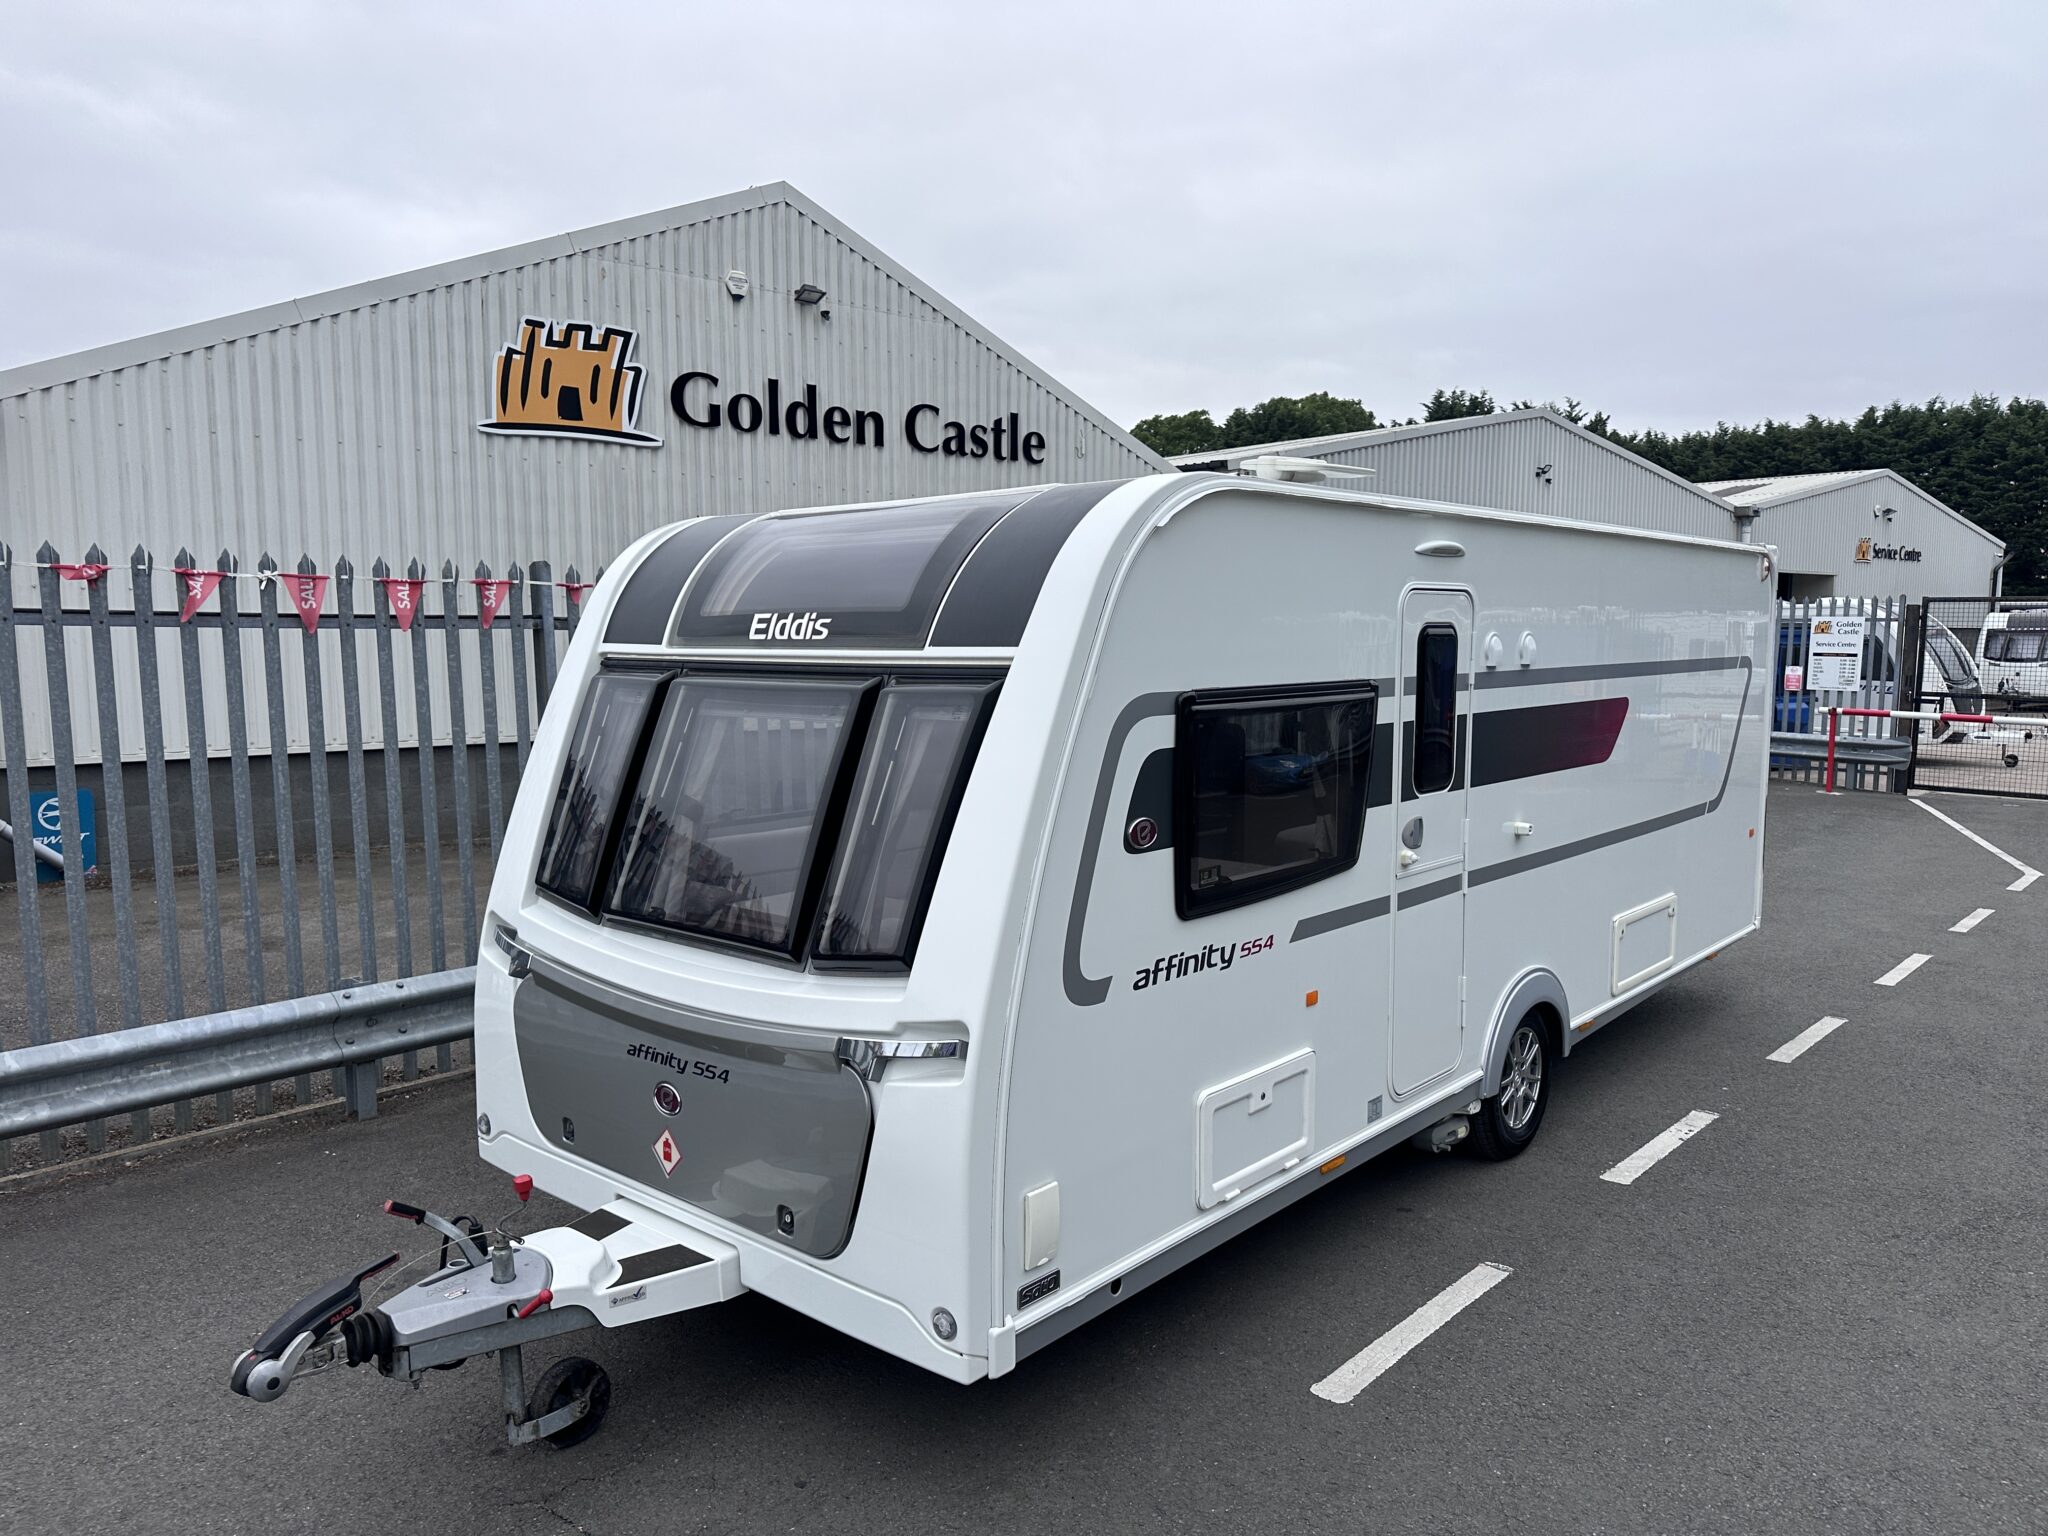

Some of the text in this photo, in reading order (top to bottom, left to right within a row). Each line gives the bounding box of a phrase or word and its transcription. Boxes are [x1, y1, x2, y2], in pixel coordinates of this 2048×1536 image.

[670, 371, 1046, 465] Golden Castle
[1872, 543, 1922, 562] Service Centre
[748, 612, 832, 640] Elddis
[1836, 620, 1862, 628] Golden
[1132, 943, 1237, 991] affinity
[626, 1043, 689, 1075] affinity
